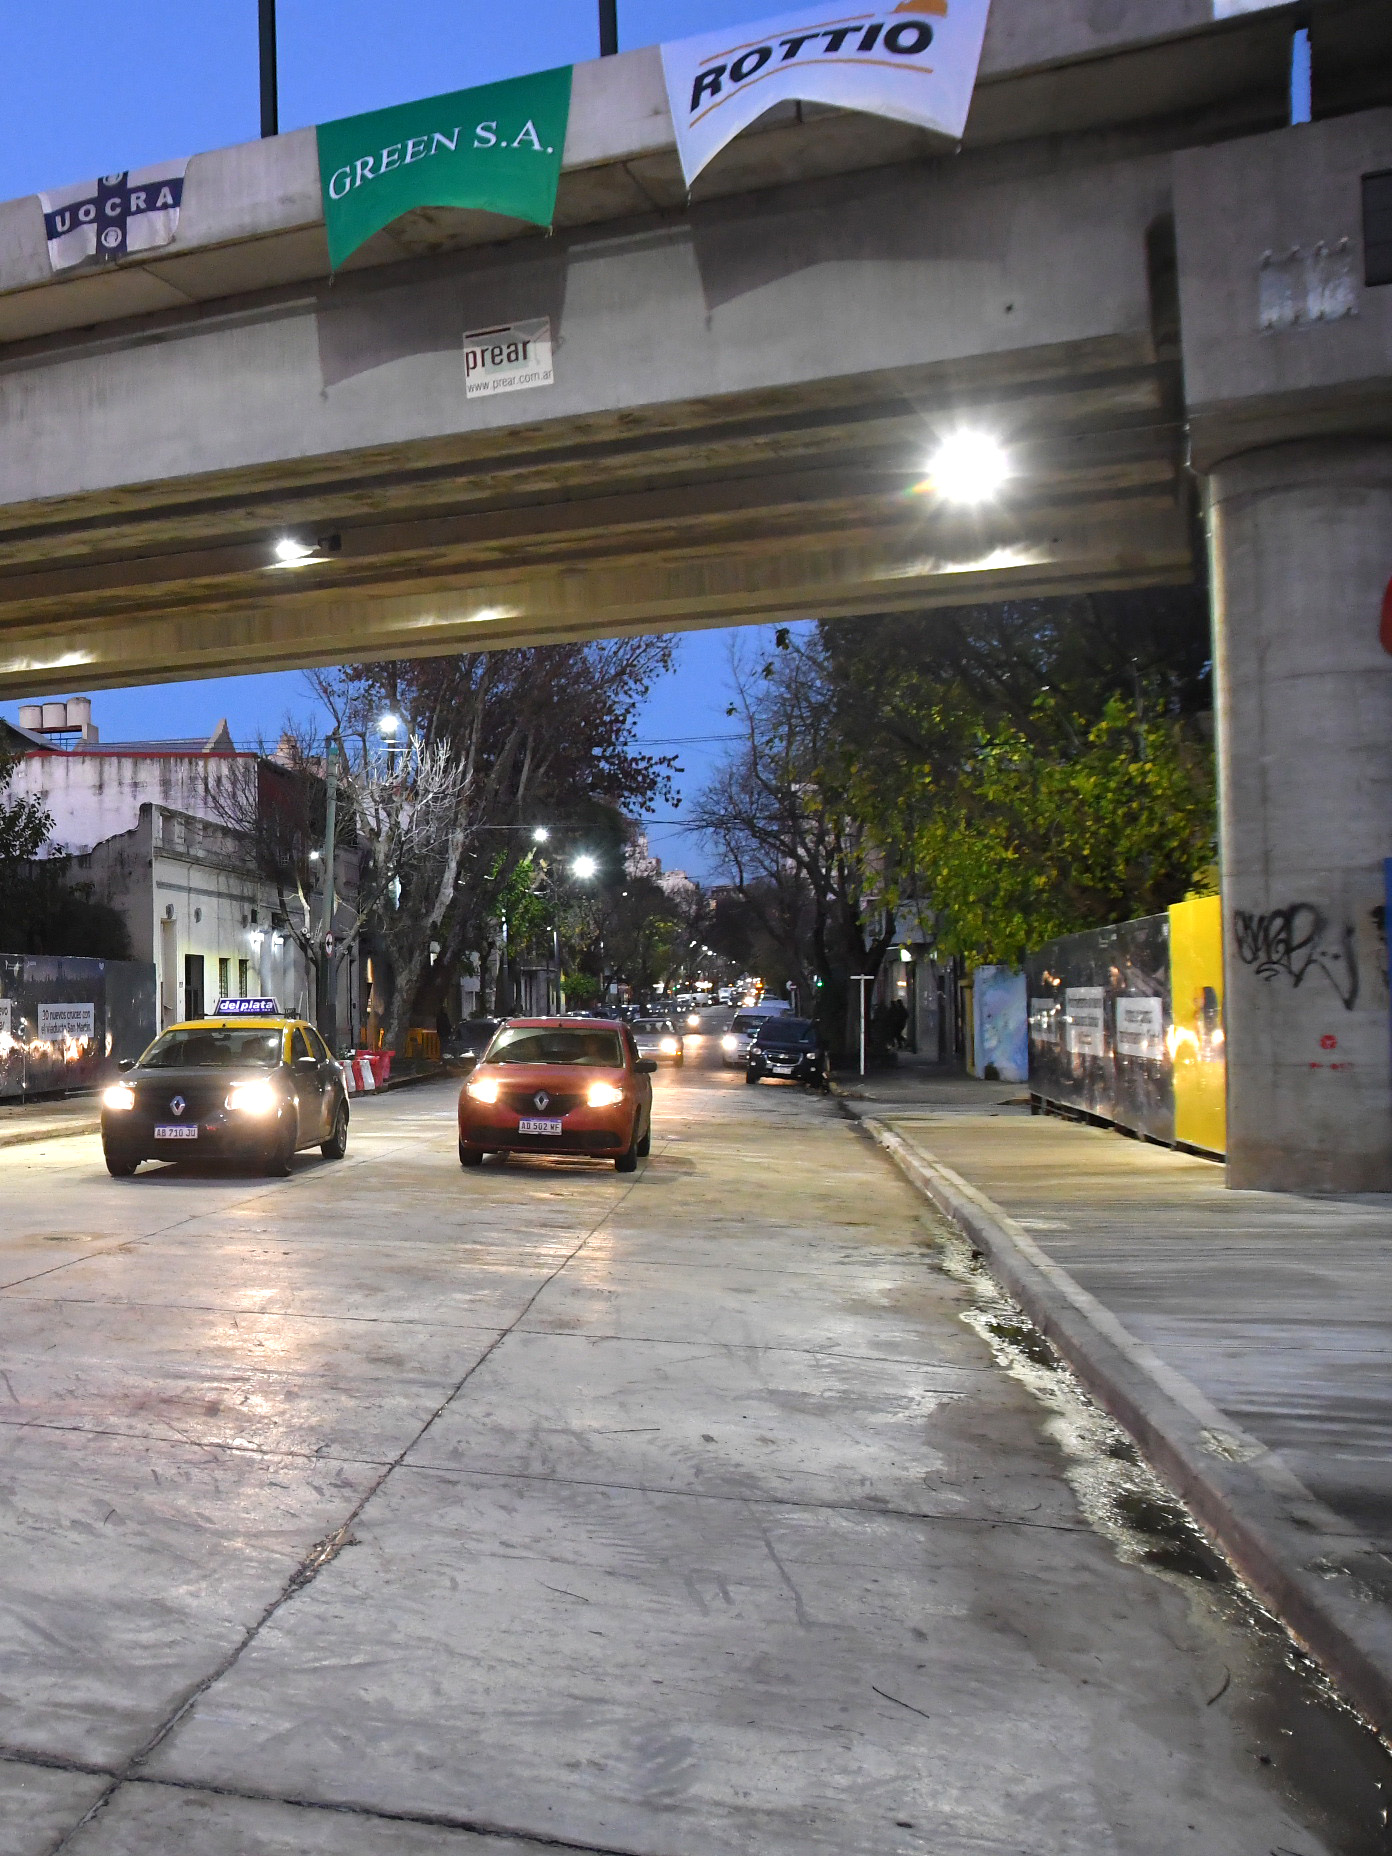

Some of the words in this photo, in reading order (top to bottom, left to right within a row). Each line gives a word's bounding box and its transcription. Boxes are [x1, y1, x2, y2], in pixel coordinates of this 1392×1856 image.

[690, 20, 933, 113] ROTTIO
[329, 127, 461, 200] GREEN
[473, 119, 553, 154] S.A.
[55, 186, 173, 232] UOCRA
[465, 339, 530, 377] prear
[533, 1122, 548, 1130] 502
